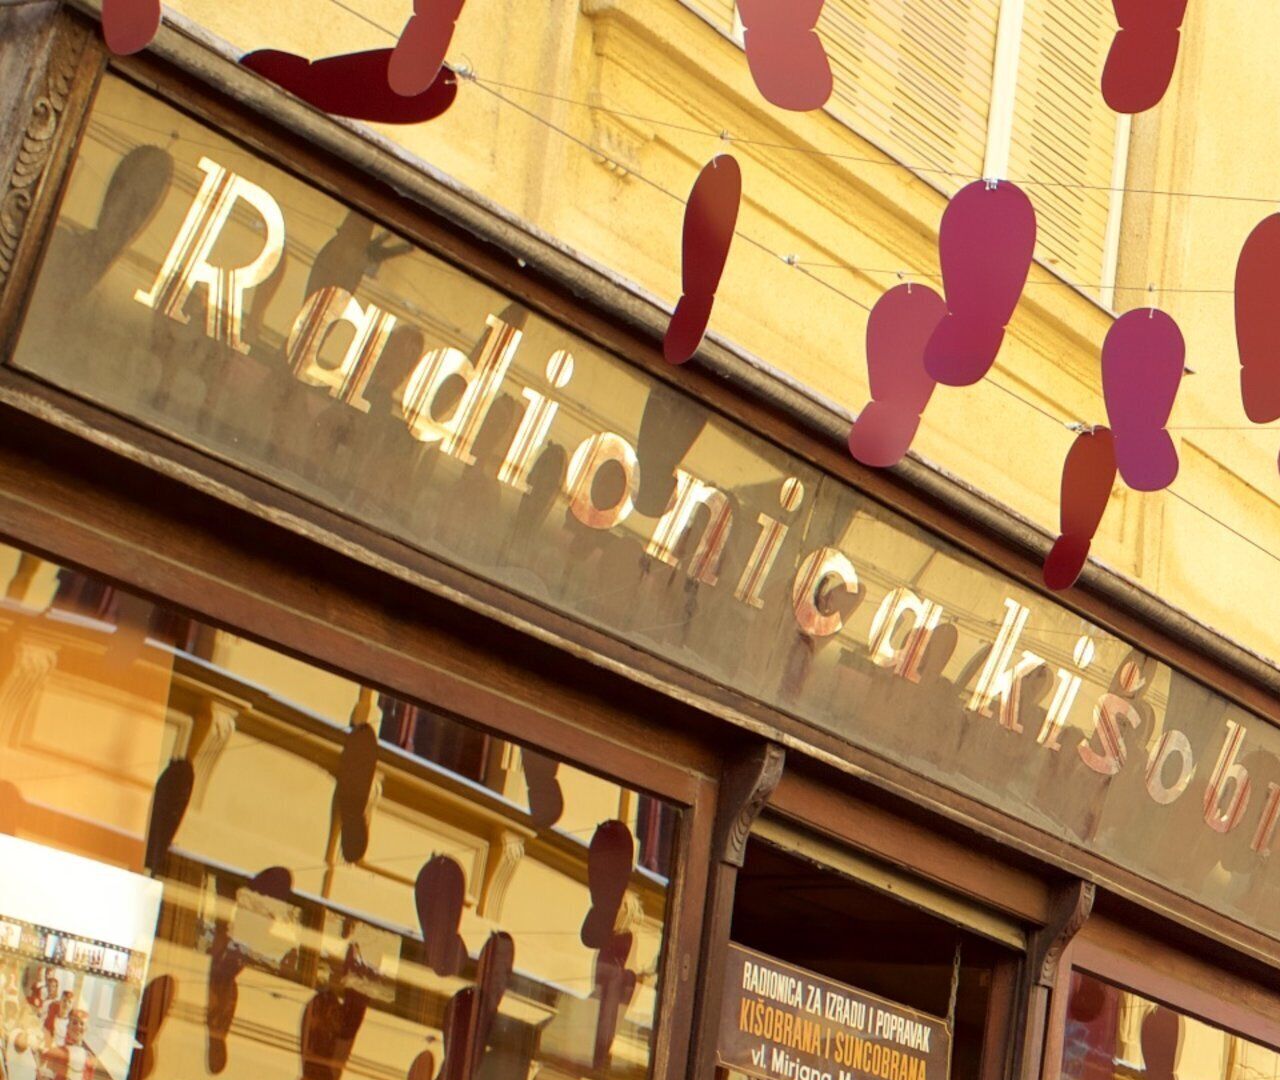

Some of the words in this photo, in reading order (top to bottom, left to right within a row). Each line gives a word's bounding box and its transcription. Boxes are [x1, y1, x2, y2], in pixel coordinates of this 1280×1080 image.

[134, 155, 943, 684] Radionica
[739, 997, 822, 1057] KIŠOBRANA
[824, 1028, 831, 1059] I
[742, 961, 802, 1009] RADIONICA
[806, 985, 823, 1015] ZA
[825, 991, 866, 1030] IZRADU
[867, 1011, 874, 1034] I
[875, 1011, 932, 1053] POPRAVAK
[751, 1045, 767, 1070] vl.
